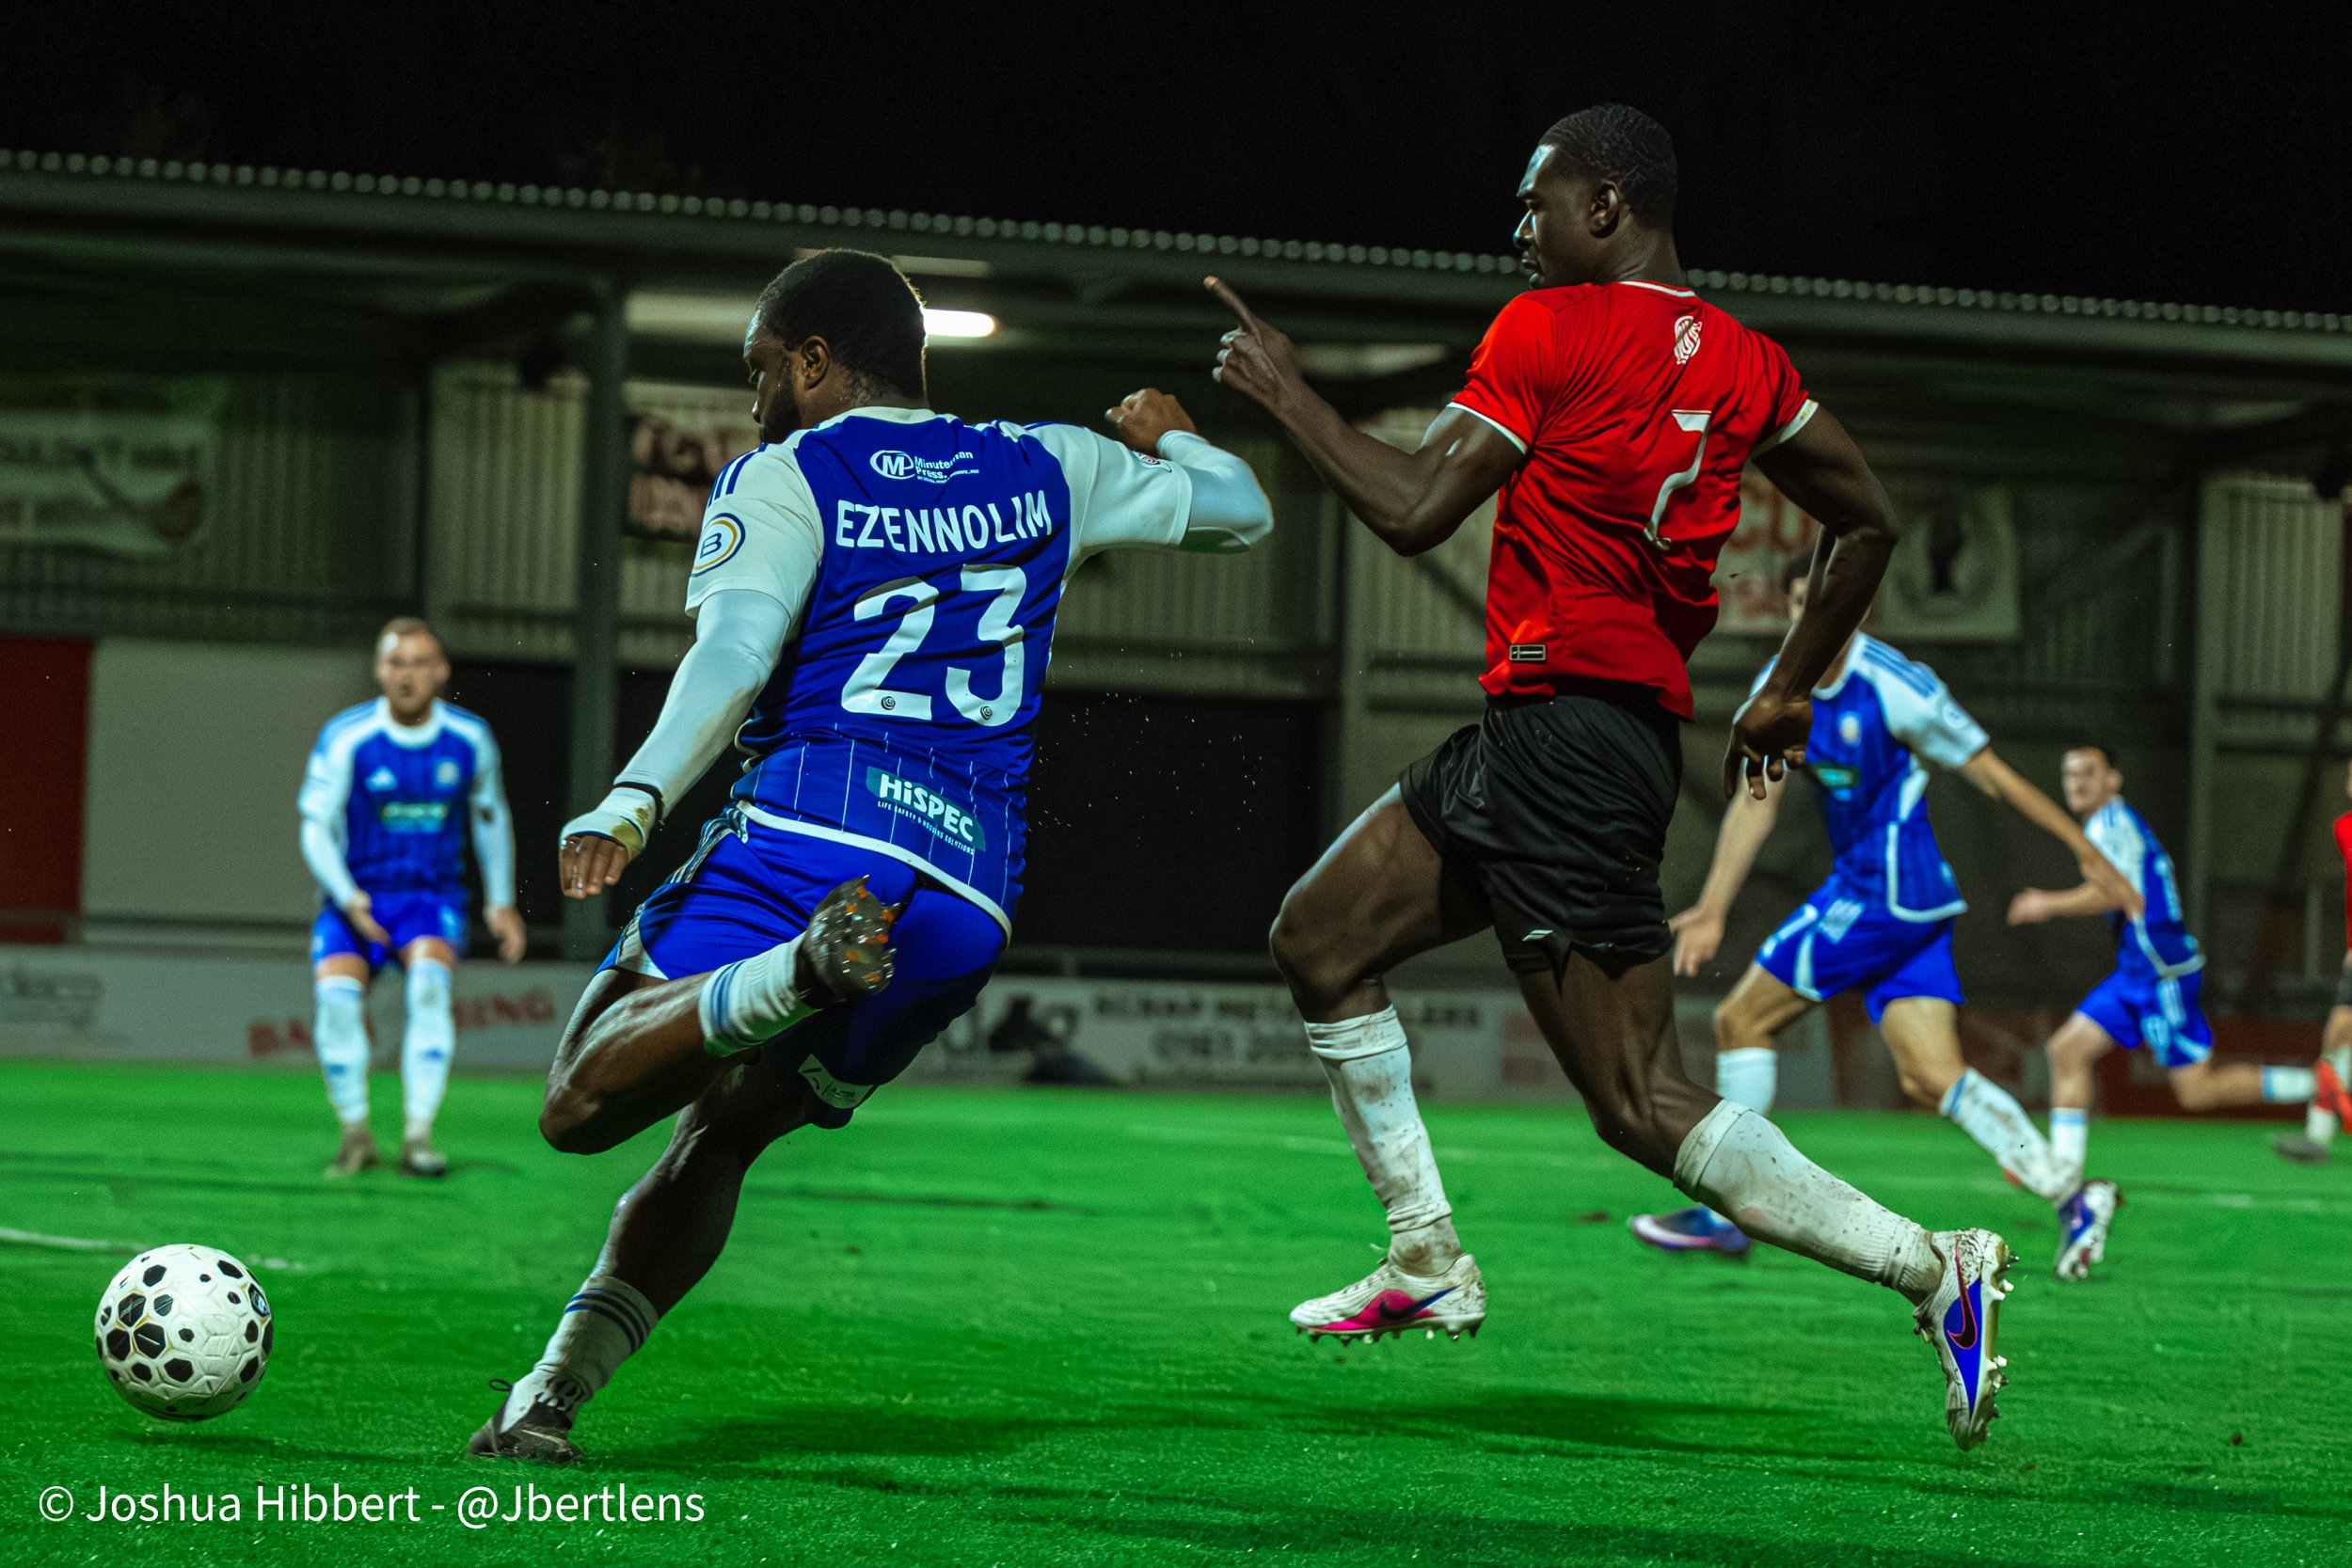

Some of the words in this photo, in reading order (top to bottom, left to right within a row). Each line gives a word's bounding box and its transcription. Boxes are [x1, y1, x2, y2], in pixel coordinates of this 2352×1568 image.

[1643, 409, 1712, 550] 7
[699, 532, 723, 560] B
[835, 490, 1053, 553] EZENNOLIM
[841, 563, 1027, 728] 23
[878, 800, 893, 811] LIFE
[894, 804, 917, 821] SAFETY
[879, 773, 975, 843] HiSPEC
